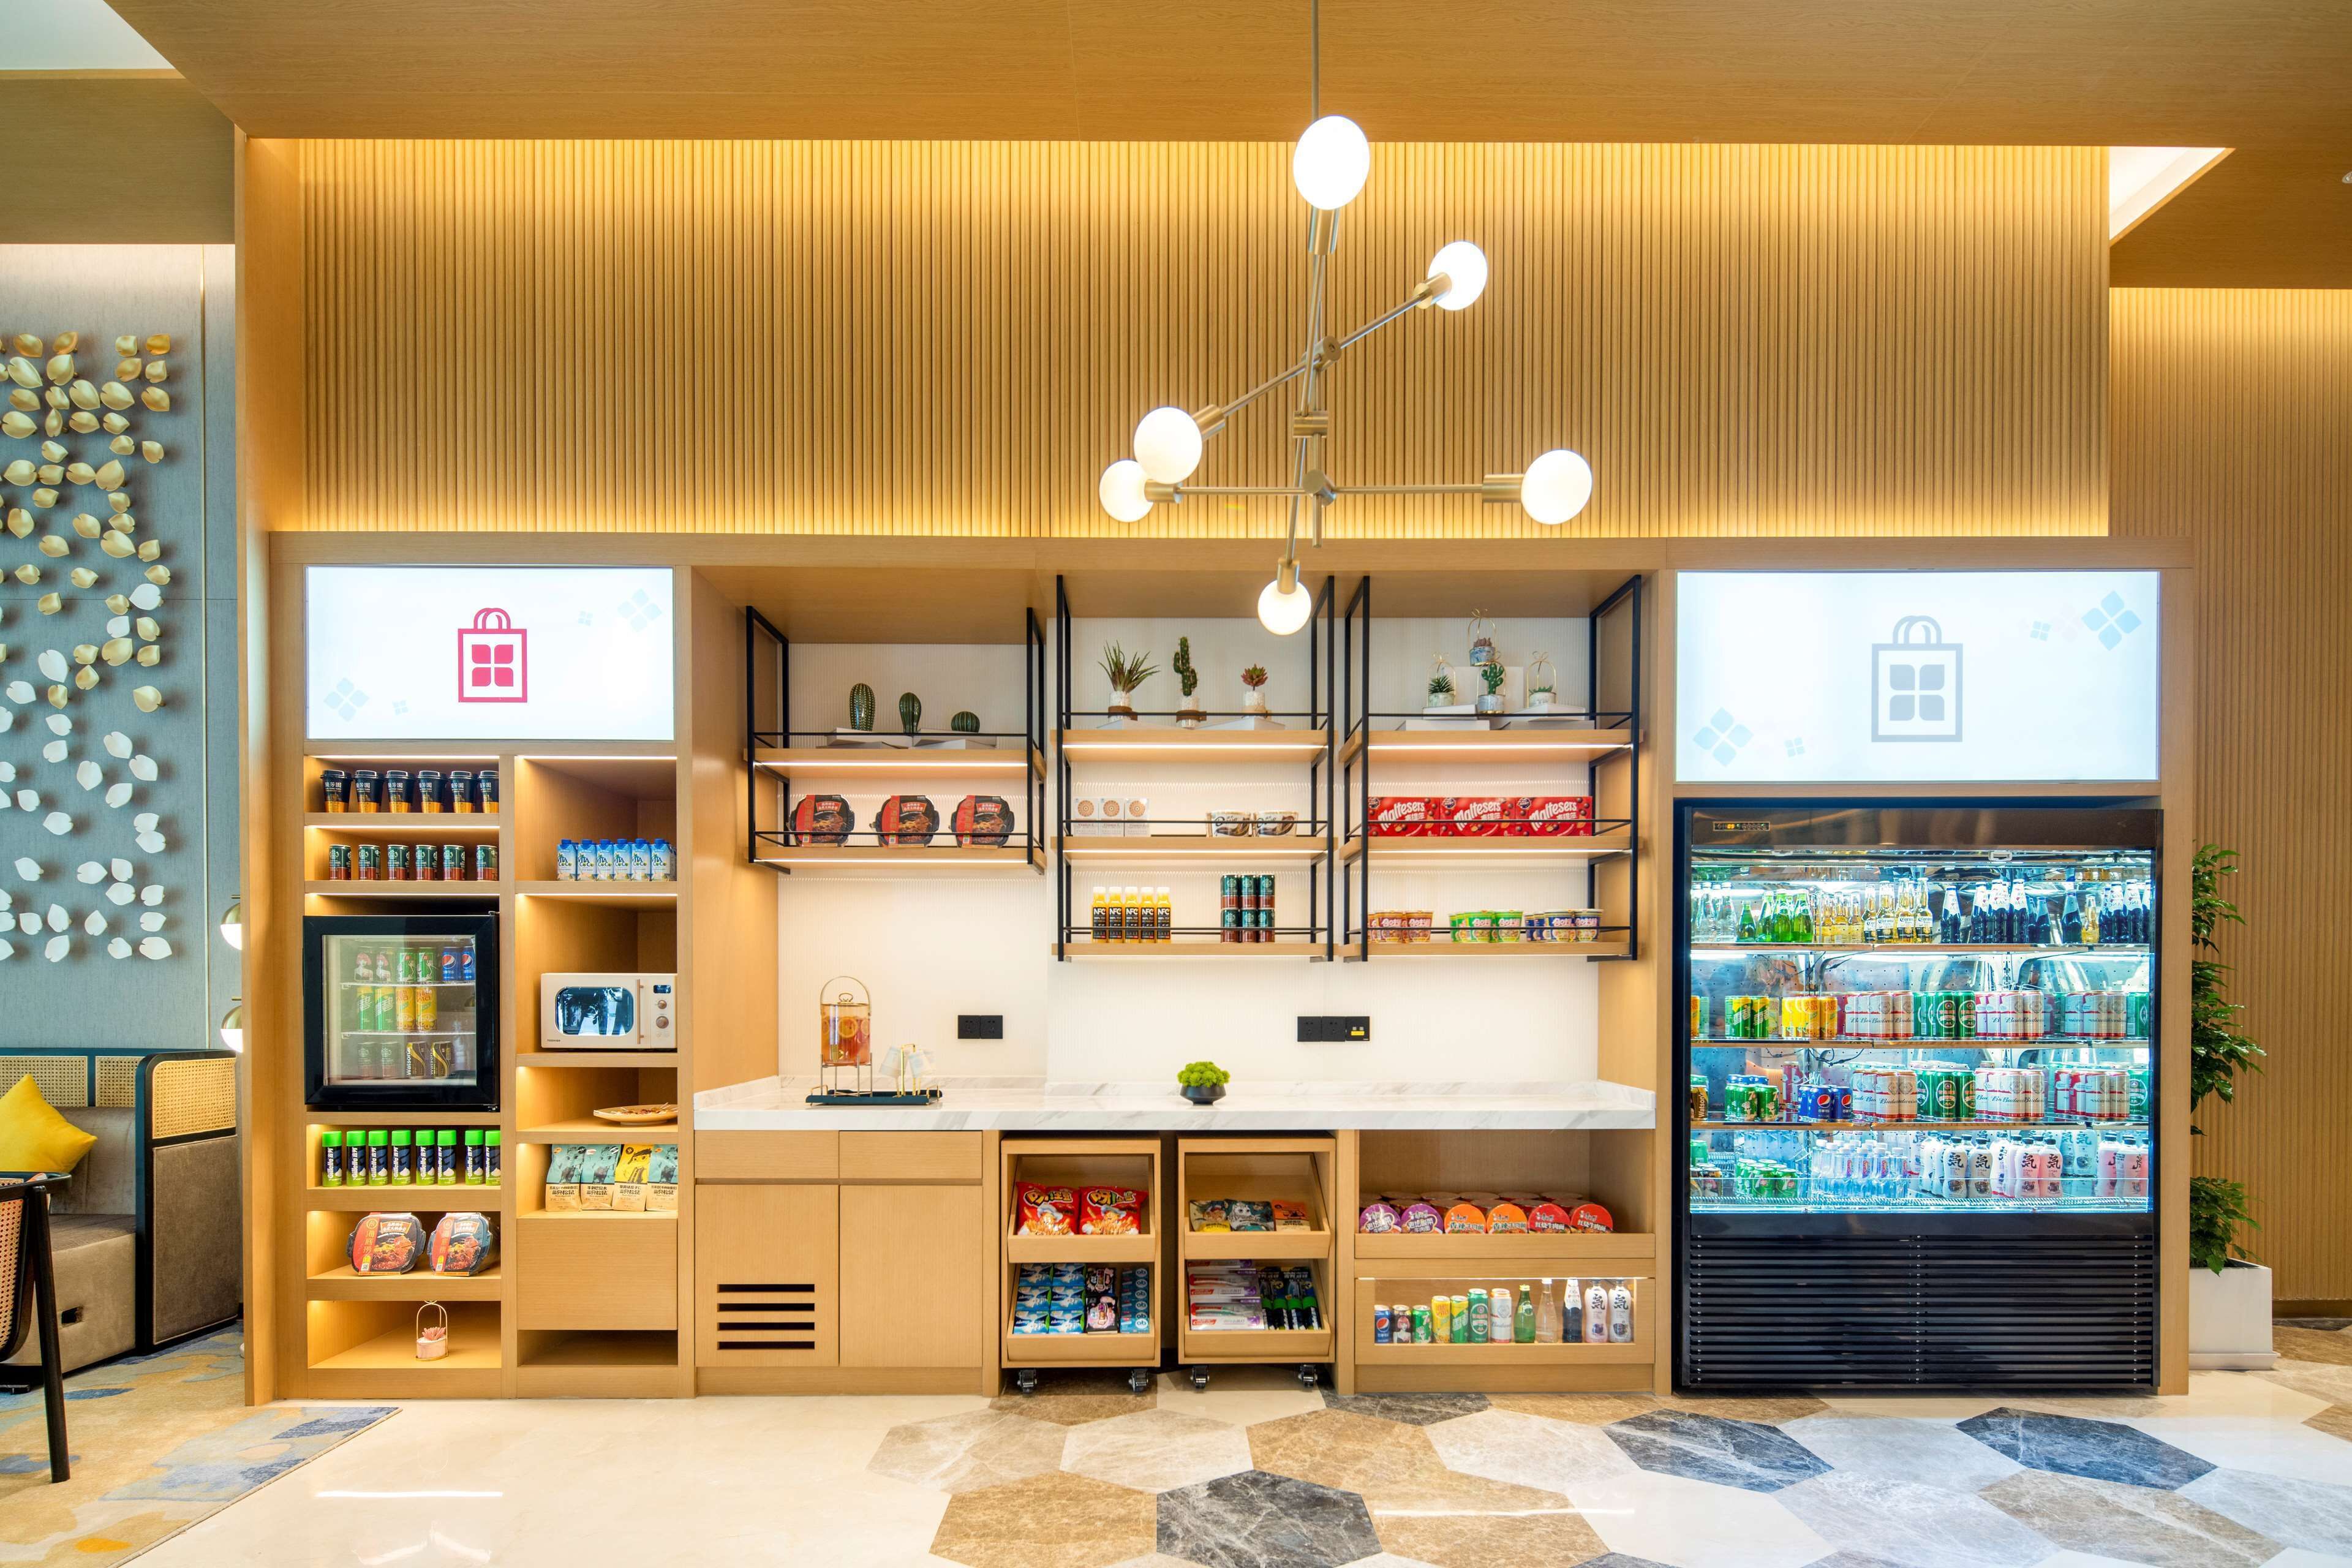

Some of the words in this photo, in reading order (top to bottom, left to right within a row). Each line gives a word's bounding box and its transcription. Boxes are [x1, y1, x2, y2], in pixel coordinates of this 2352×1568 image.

[1378, 802, 1425, 831] Maltesers
[1453, 802, 1501, 831] Maltesers
[1529, 802, 1577, 831] Maltesers
